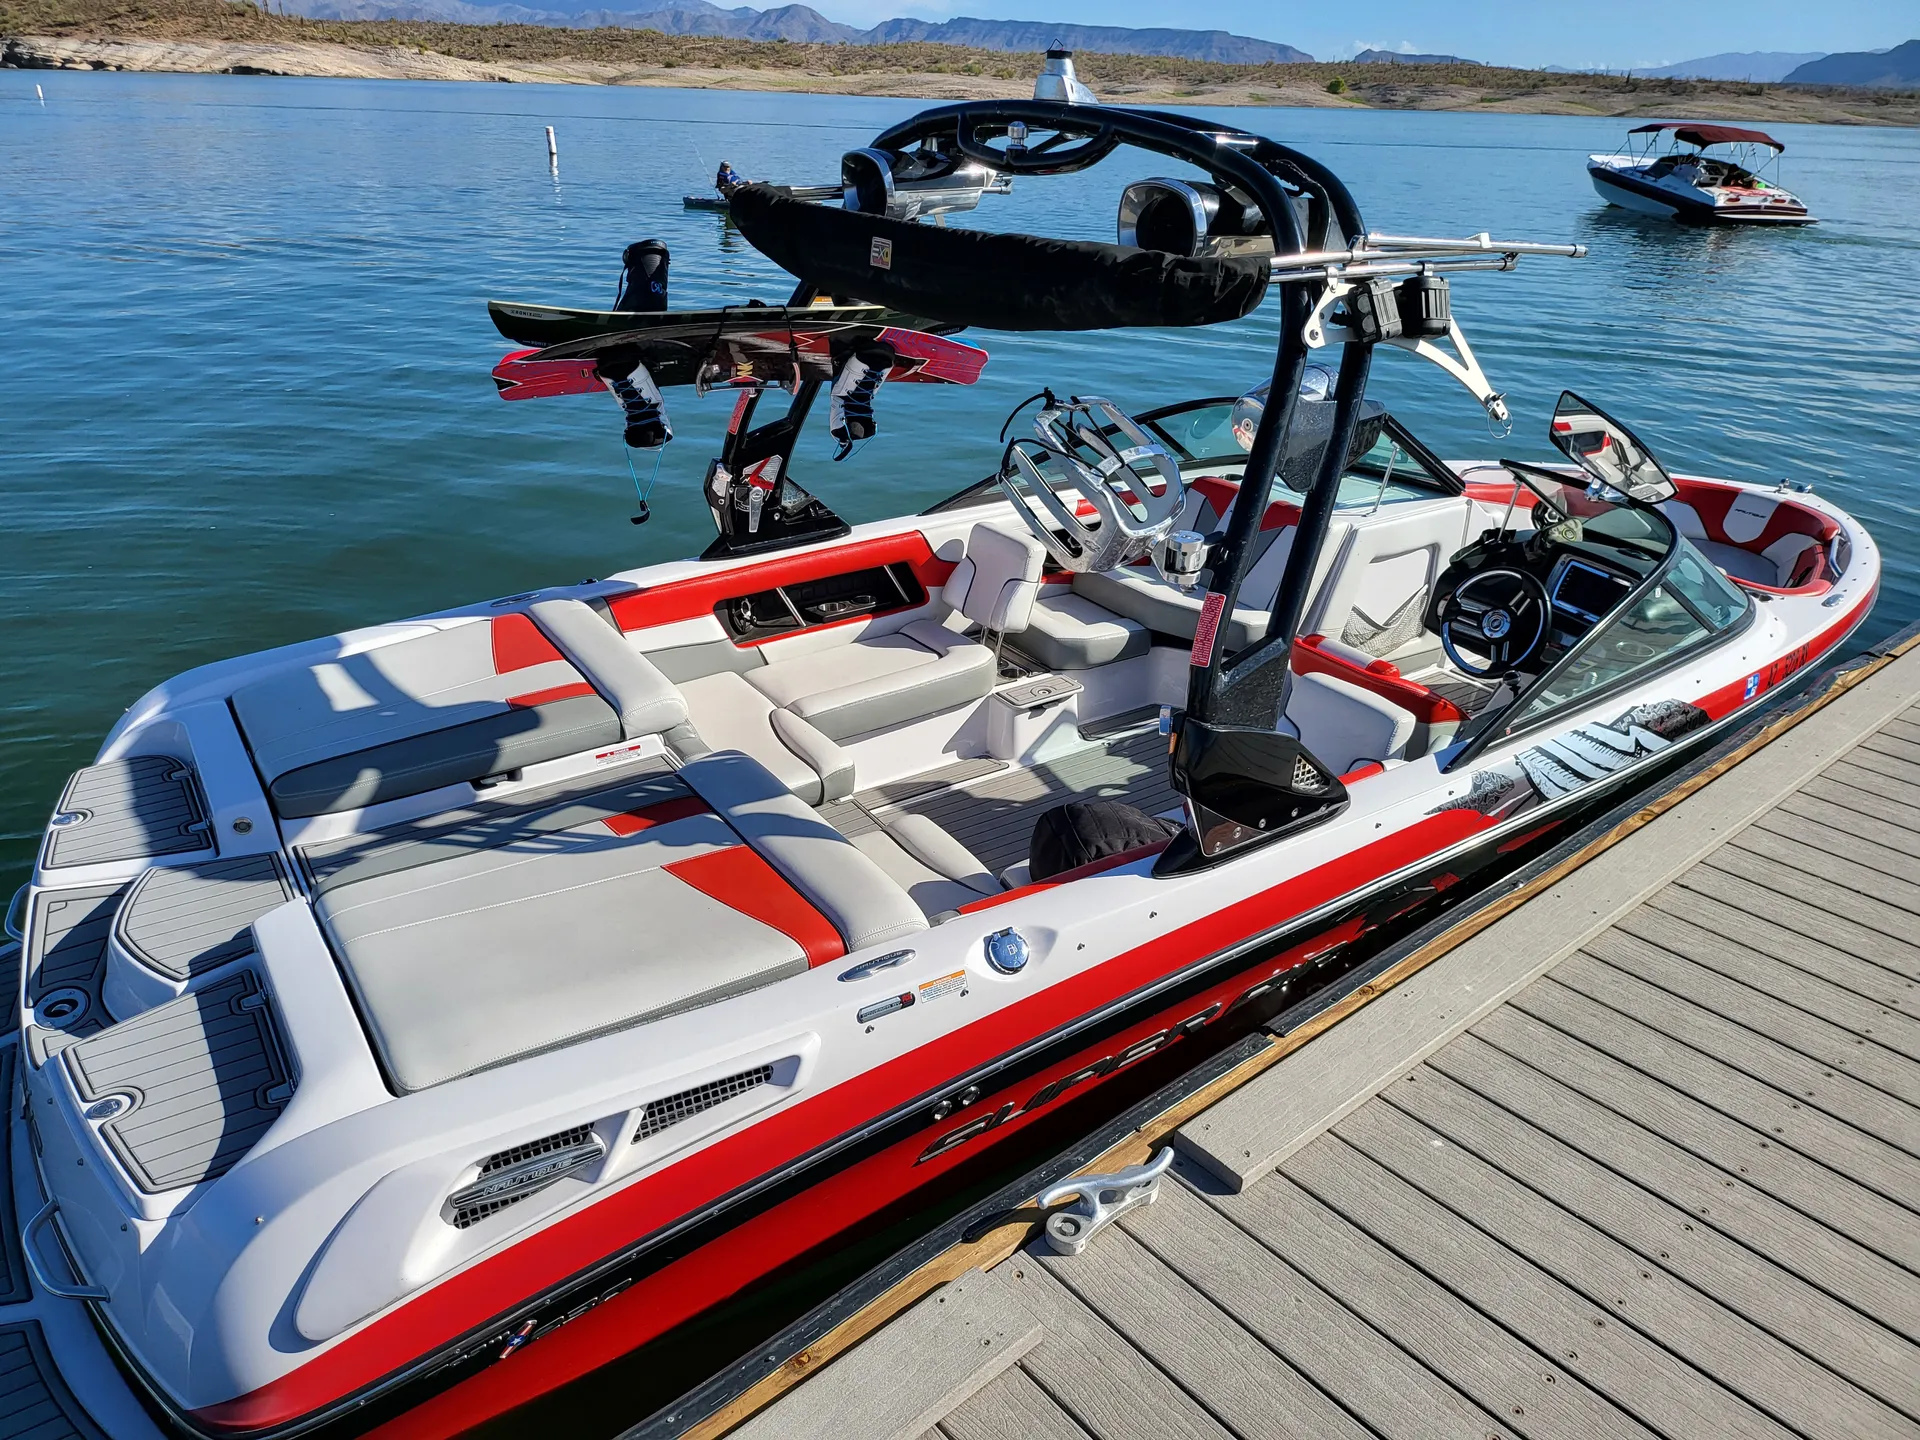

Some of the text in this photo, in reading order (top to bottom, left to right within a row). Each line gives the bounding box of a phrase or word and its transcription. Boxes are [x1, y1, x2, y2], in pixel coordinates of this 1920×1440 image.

[856, 950, 903, 970] NAUTIQUE
[909, 1003, 1223, 1167] SUPER
[482, 1158, 573, 1195] NAUTIQUE
